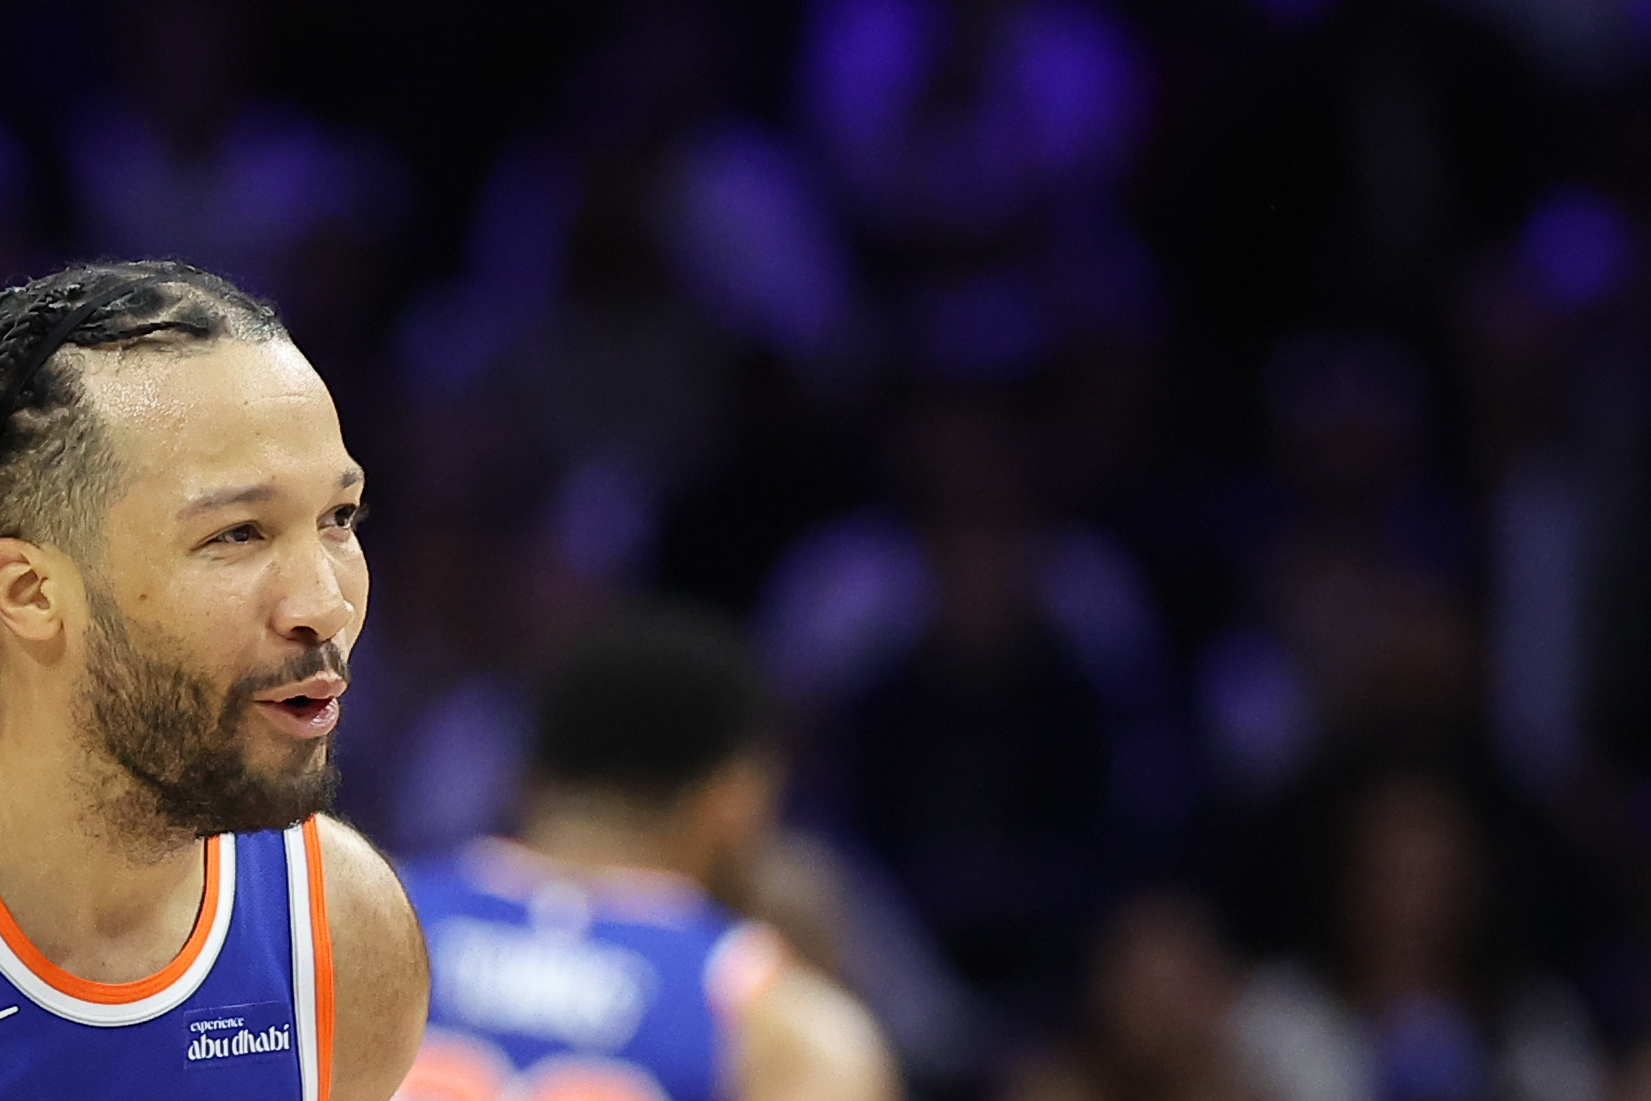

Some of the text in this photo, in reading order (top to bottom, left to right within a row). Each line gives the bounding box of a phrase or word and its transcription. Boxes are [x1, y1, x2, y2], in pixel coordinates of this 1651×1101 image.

[190, 1017, 245, 1033] experience
[188, 1024, 290, 1061] abu dhabi
